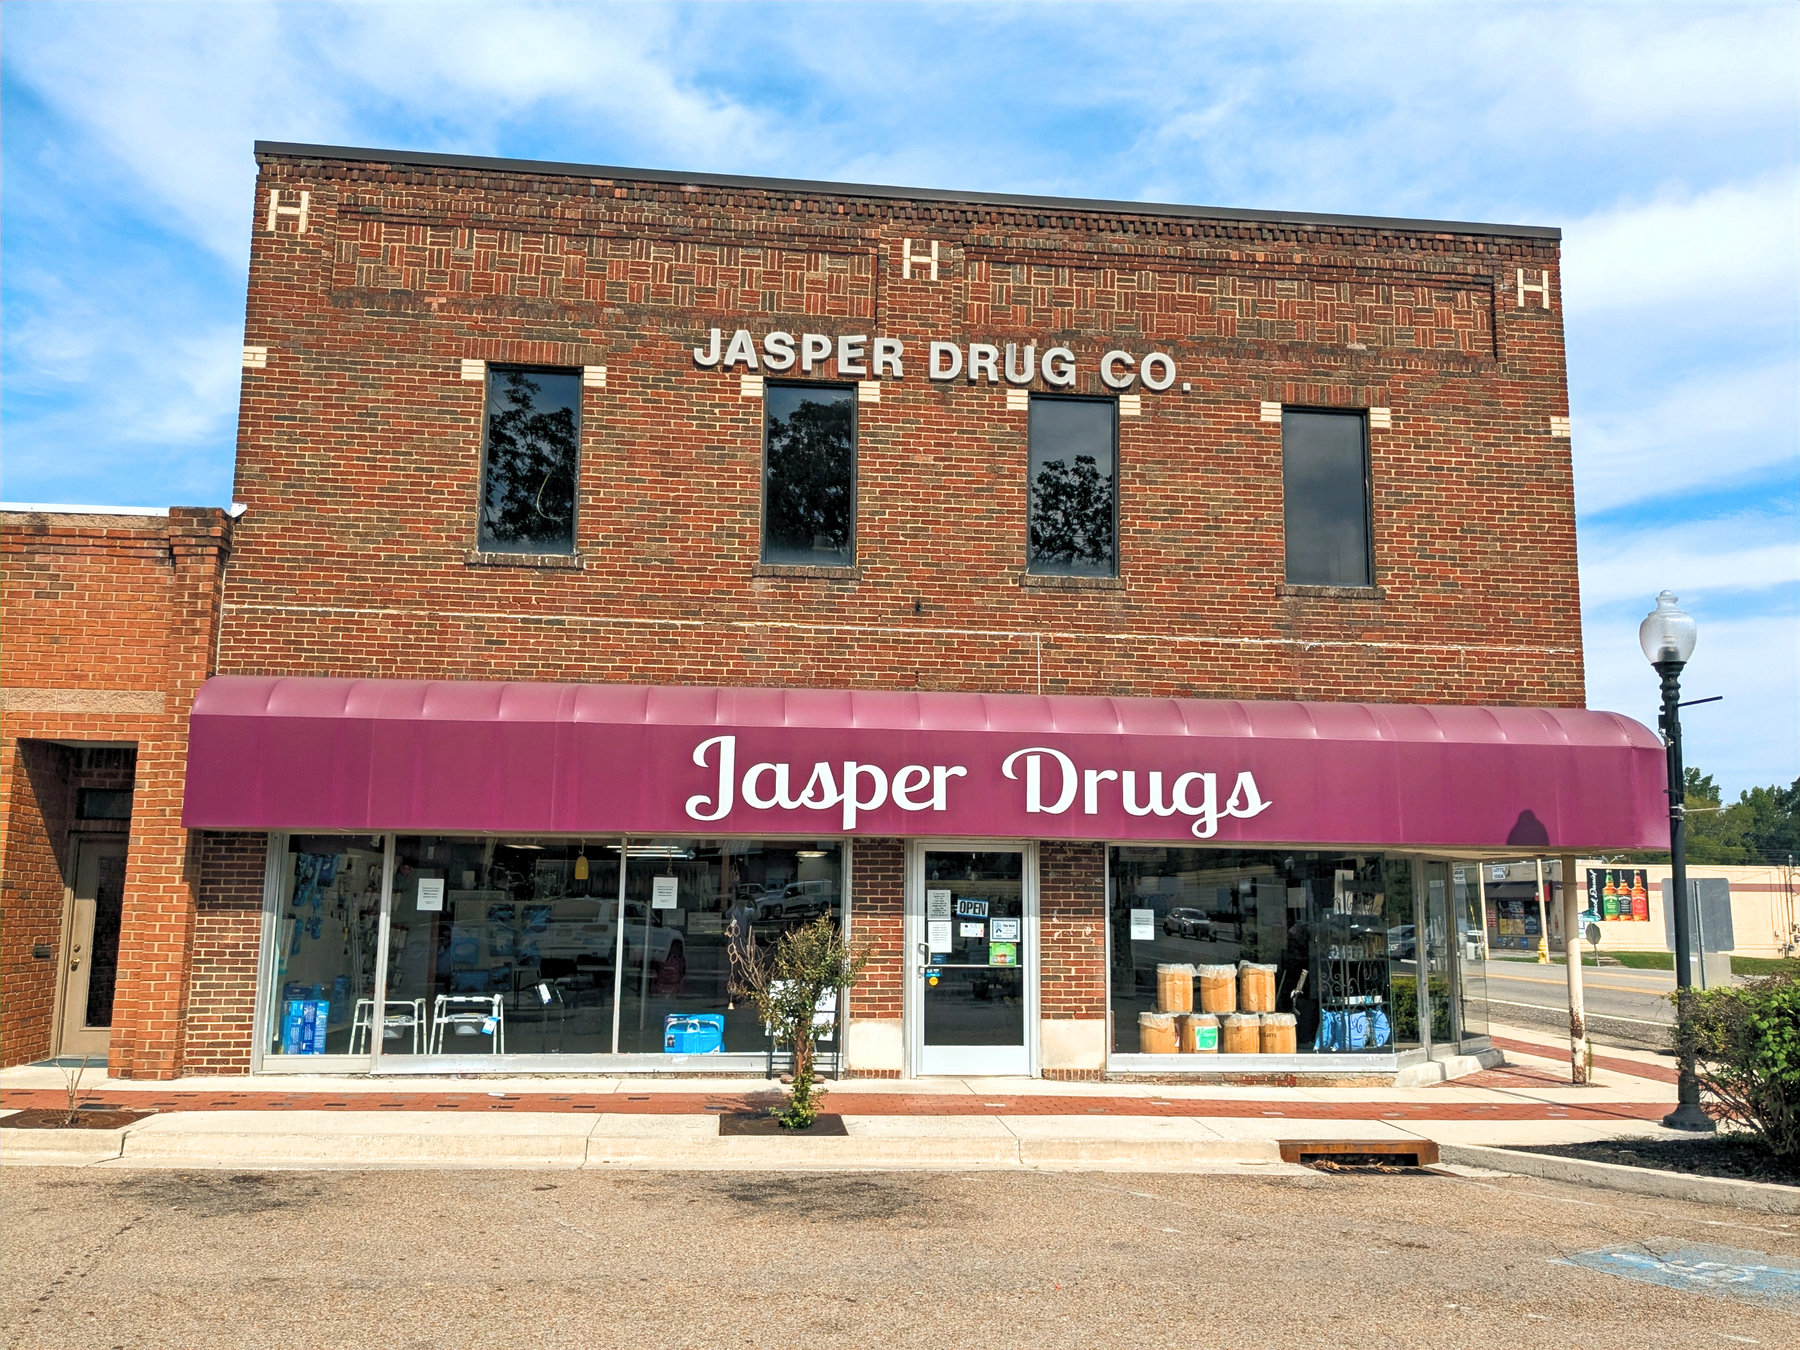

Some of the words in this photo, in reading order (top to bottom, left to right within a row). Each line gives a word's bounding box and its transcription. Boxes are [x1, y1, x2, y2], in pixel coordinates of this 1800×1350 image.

[694, 328, 904, 378] JASPER
[929, 340, 1076, 387] DRUG
[1100, 350, 1191, 392] CO.
[685, 735, 967, 831] Jasper
[1002, 747, 1273, 838] Drugs
[959, 900, 987, 916] OPEN
